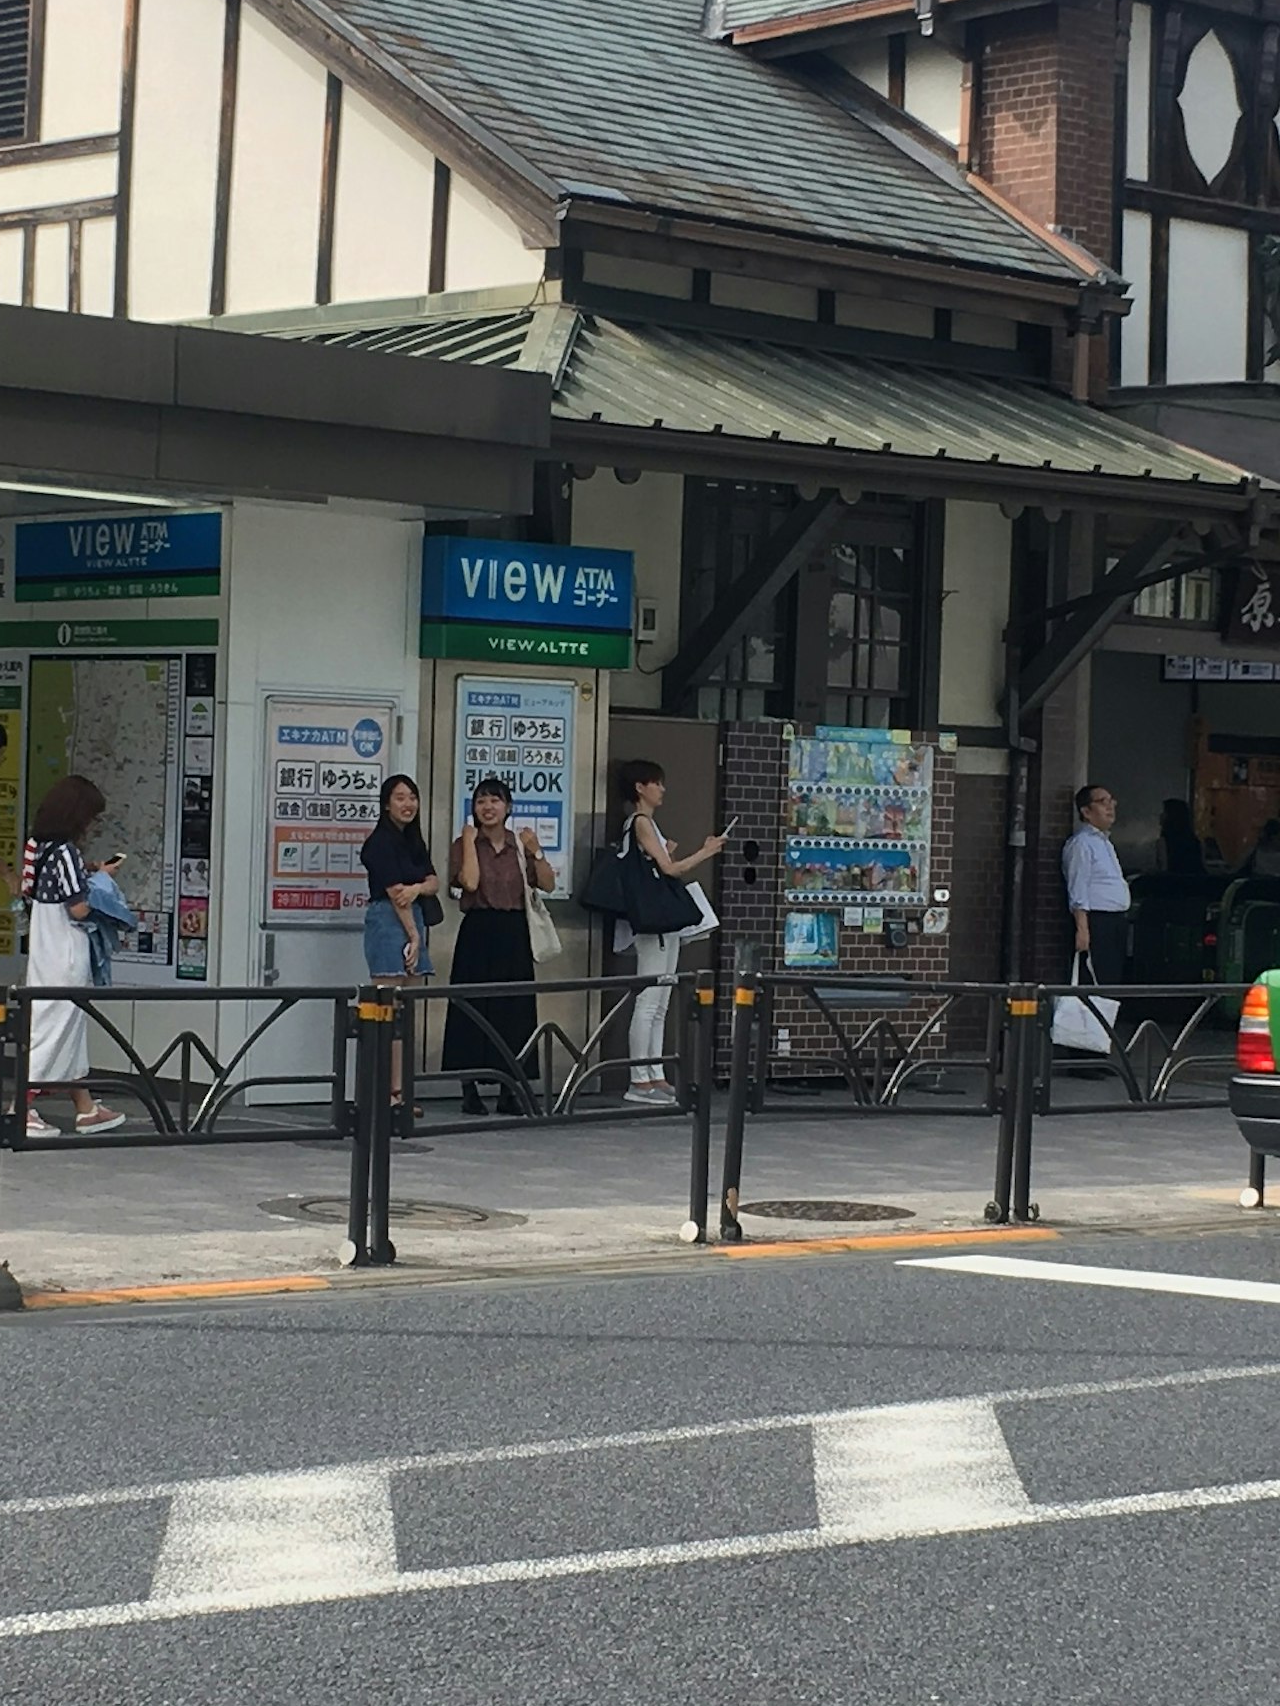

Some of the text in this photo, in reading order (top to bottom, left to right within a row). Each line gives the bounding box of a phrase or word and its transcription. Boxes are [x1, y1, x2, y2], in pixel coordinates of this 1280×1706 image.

[140, 522, 168, 540] ATM
[139, 541, 171, 554] コーナー
[86, 559, 116, 569] VIEW
[574, 567, 615, 591] ATM
[573, 589, 619, 608] コーナー
[488, 637, 589, 655] VIEW ALTTE
[470, 694, 520, 707] エキナカATM
[281, 729, 346, 743] エキナカATM
[471, 718, 562, 740] 銀行 ゆうちょ
[359, 741, 375, 753] OK
[524, 750, 562, 765] ろうきん
[279, 767, 378, 790] 銀行 ゆうちょ
[337, 803, 380, 818] ろうきん
